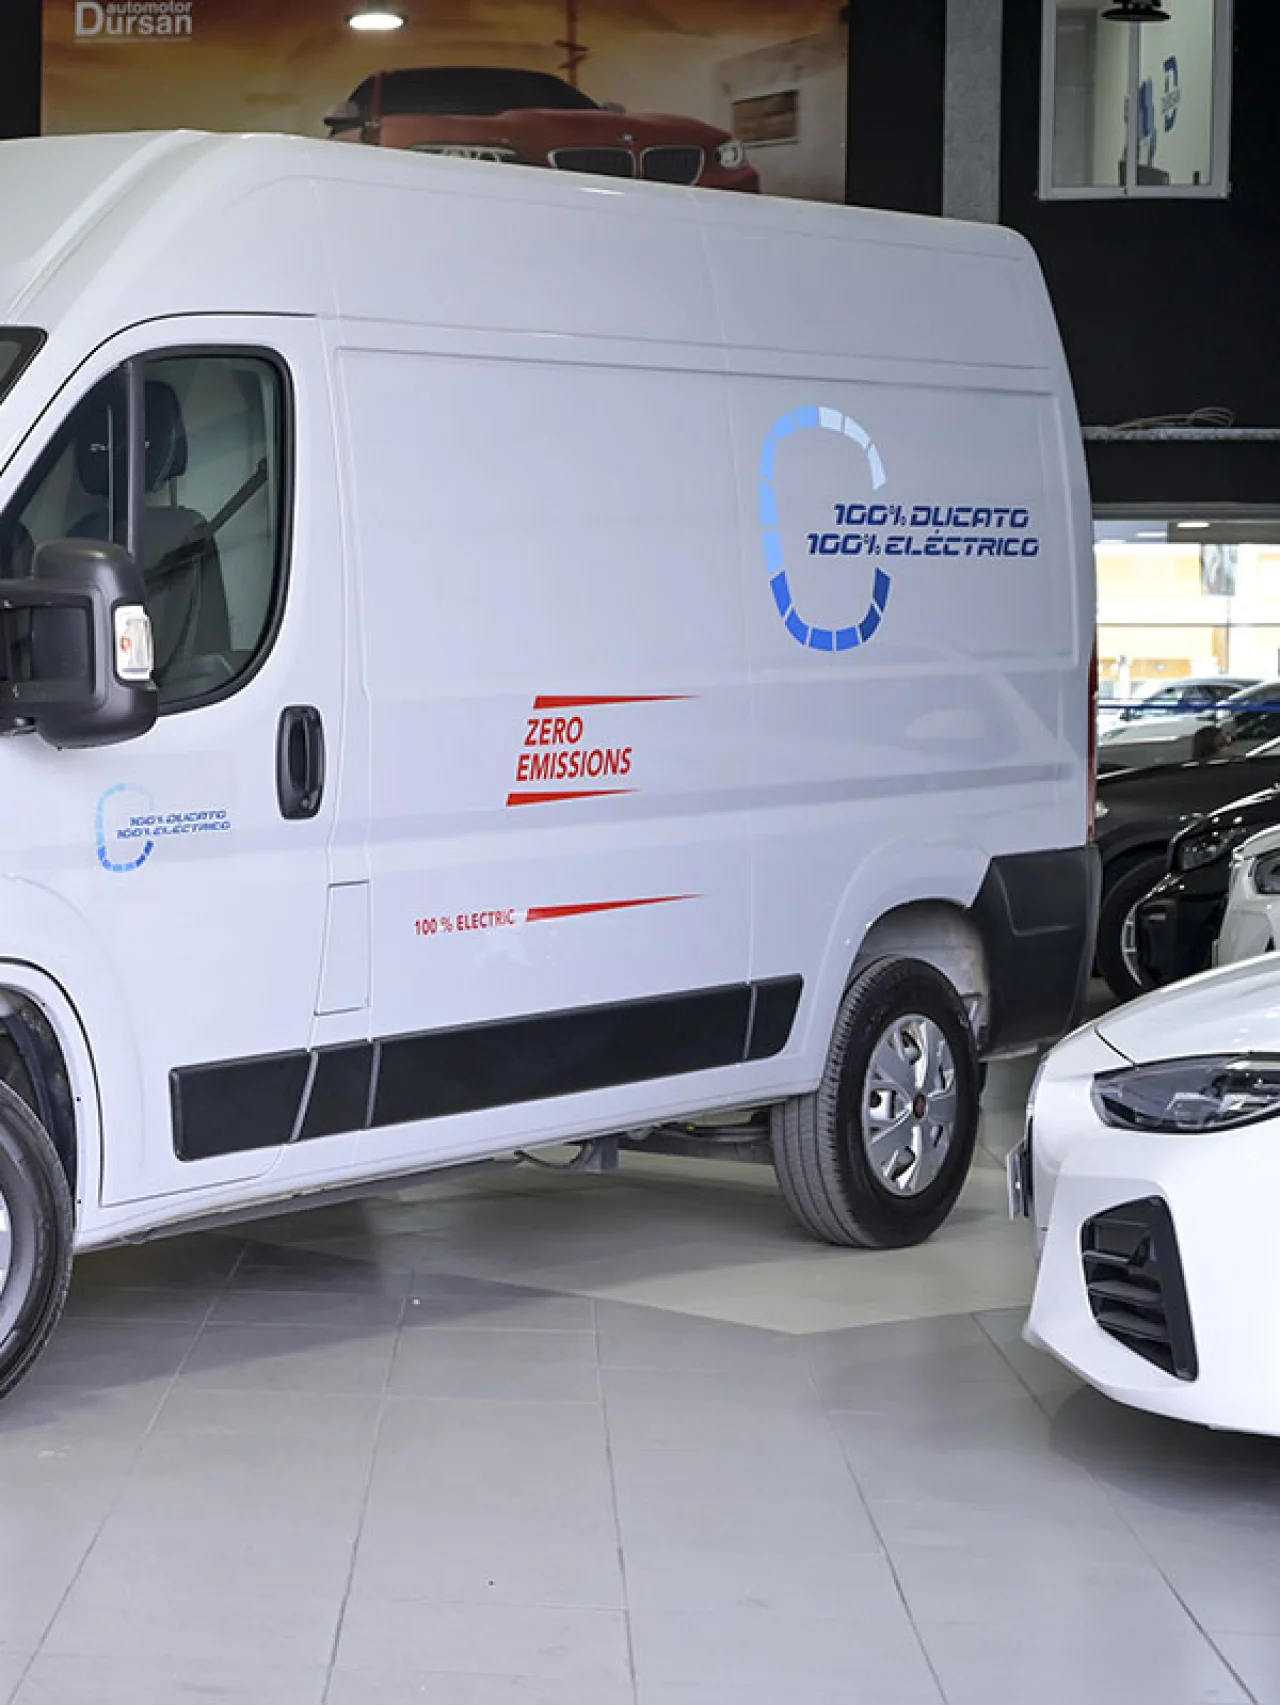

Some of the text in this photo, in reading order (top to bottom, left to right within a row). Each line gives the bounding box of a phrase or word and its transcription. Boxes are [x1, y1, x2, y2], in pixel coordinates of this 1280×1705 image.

[75, 1, 193, 35] Dursan
[106, 0, 191, 13] automotor
[834, 503, 1029, 528] 100% DUCATO
[806, 532, 881, 556] 100%
[524, 716, 584, 746] ZERO
[516, 747, 633, 782] EMISSIONS
[414, 917, 438, 936] 100
[456, 908, 515, 931] ELECTRIC
